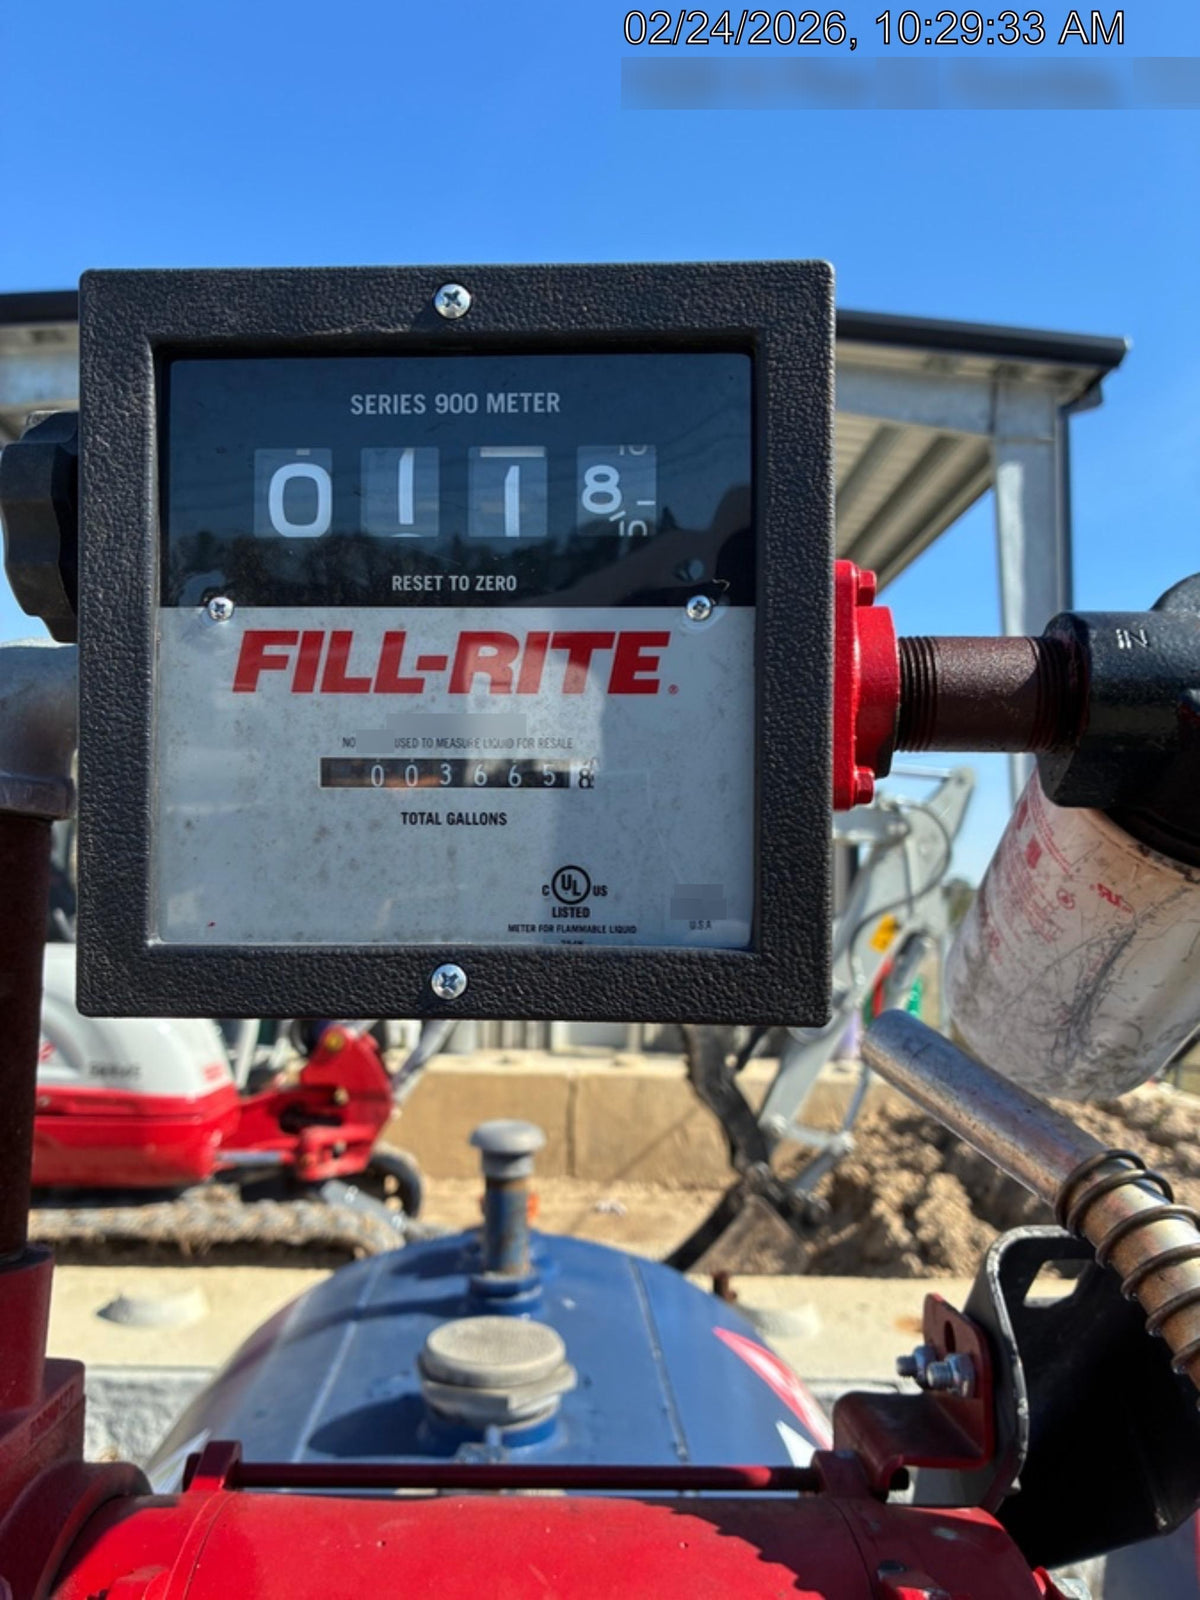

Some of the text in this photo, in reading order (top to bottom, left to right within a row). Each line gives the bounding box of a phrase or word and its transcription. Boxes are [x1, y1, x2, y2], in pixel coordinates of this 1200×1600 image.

[350, 392, 560, 416] SERIES 900 METER
[391, 575, 518, 592] RESET TO ZERO
[232, 630, 671, 695] FILL-RITE
[394, 738, 419, 749] USED
[421, 738, 434, 749] TO
[435, 738, 480, 749] MEASURE
[482, 738, 514, 749] LIQUID
[516, 738, 535, 749] FOR
[537, 738, 574, 749] RESALE
[401, 812, 508, 827] TOTAL GALLONS
[561, 874, 582, 896] UL
[592, 884, 608, 897] US
[552, 906, 591, 918] LISTED
[508, 924, 637, 934] METER FOR FLAMMABLE LIQUID
